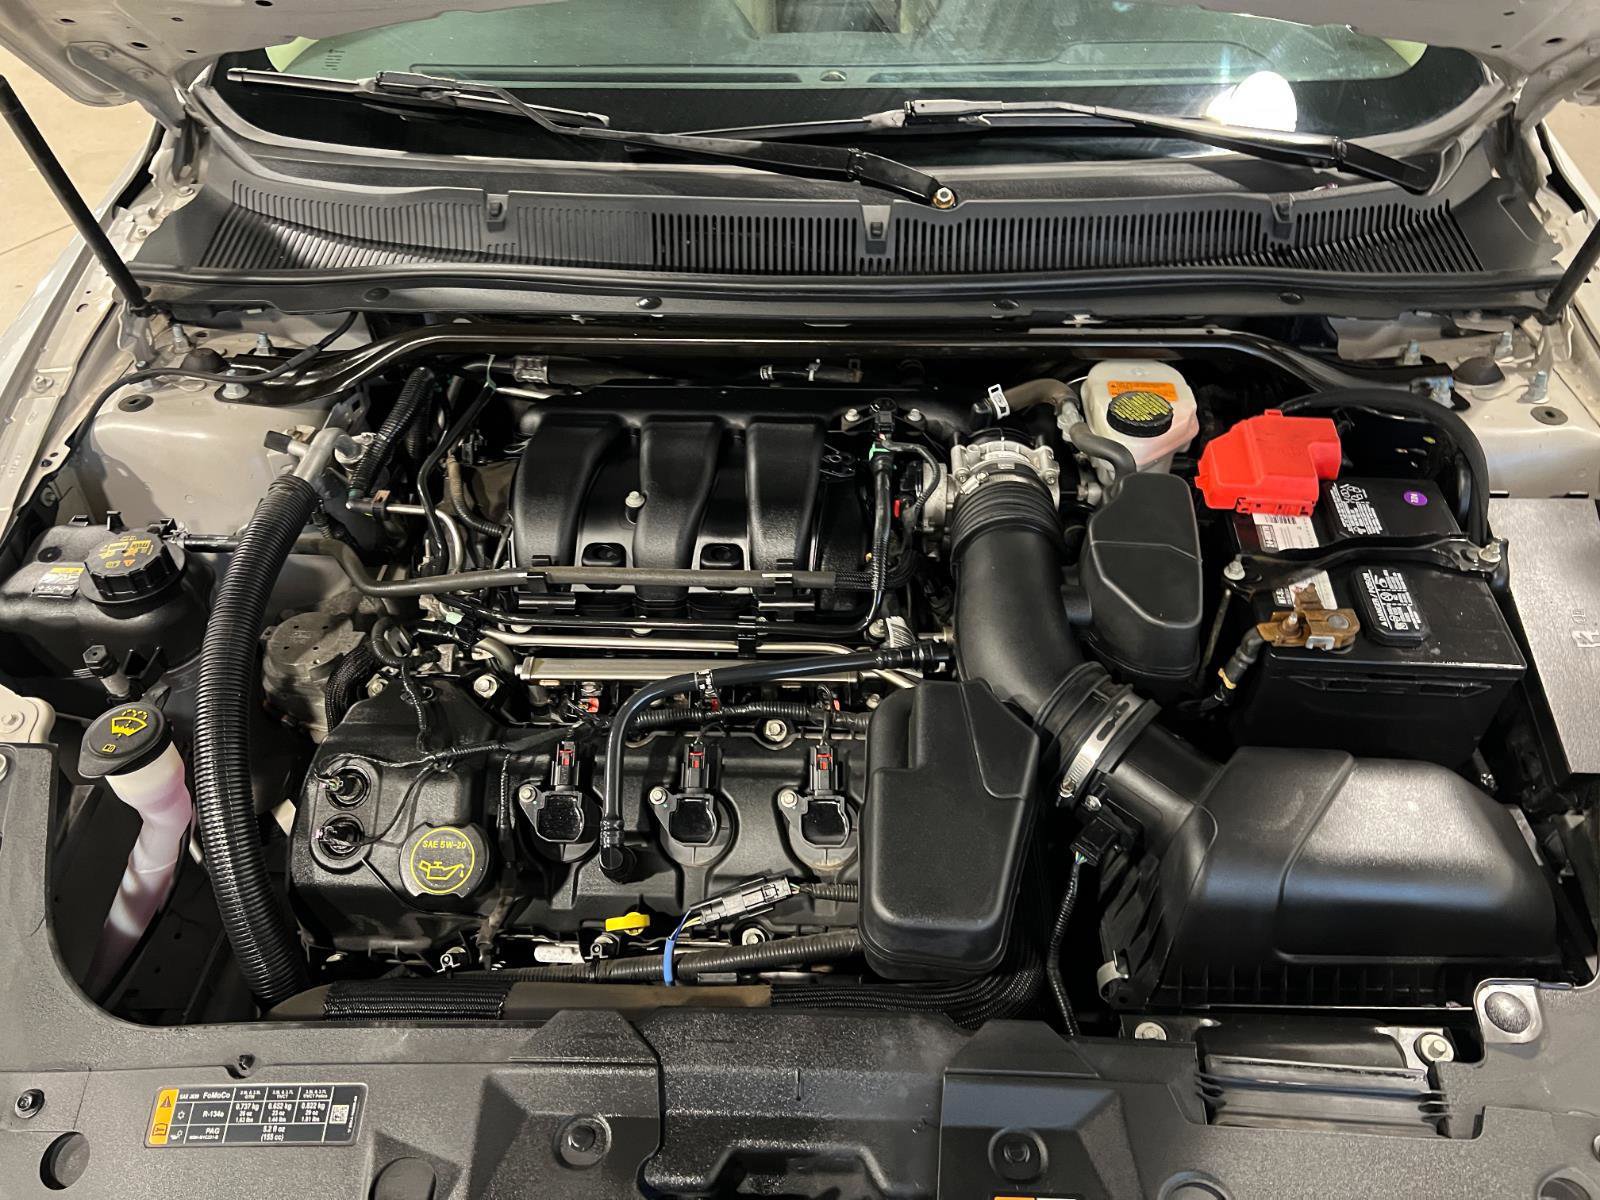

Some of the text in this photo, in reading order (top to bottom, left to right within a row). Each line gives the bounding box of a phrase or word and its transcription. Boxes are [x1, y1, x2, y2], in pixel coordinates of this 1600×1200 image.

[422, 840, 466, 849] SAE 5W-20
[202, 1092, 230, 1100] FoMoCo
[252, 1102, 260, 1111] kg
[284, 1102, 292, 1111] kg
[318, 1102, 326, 1111] kg
